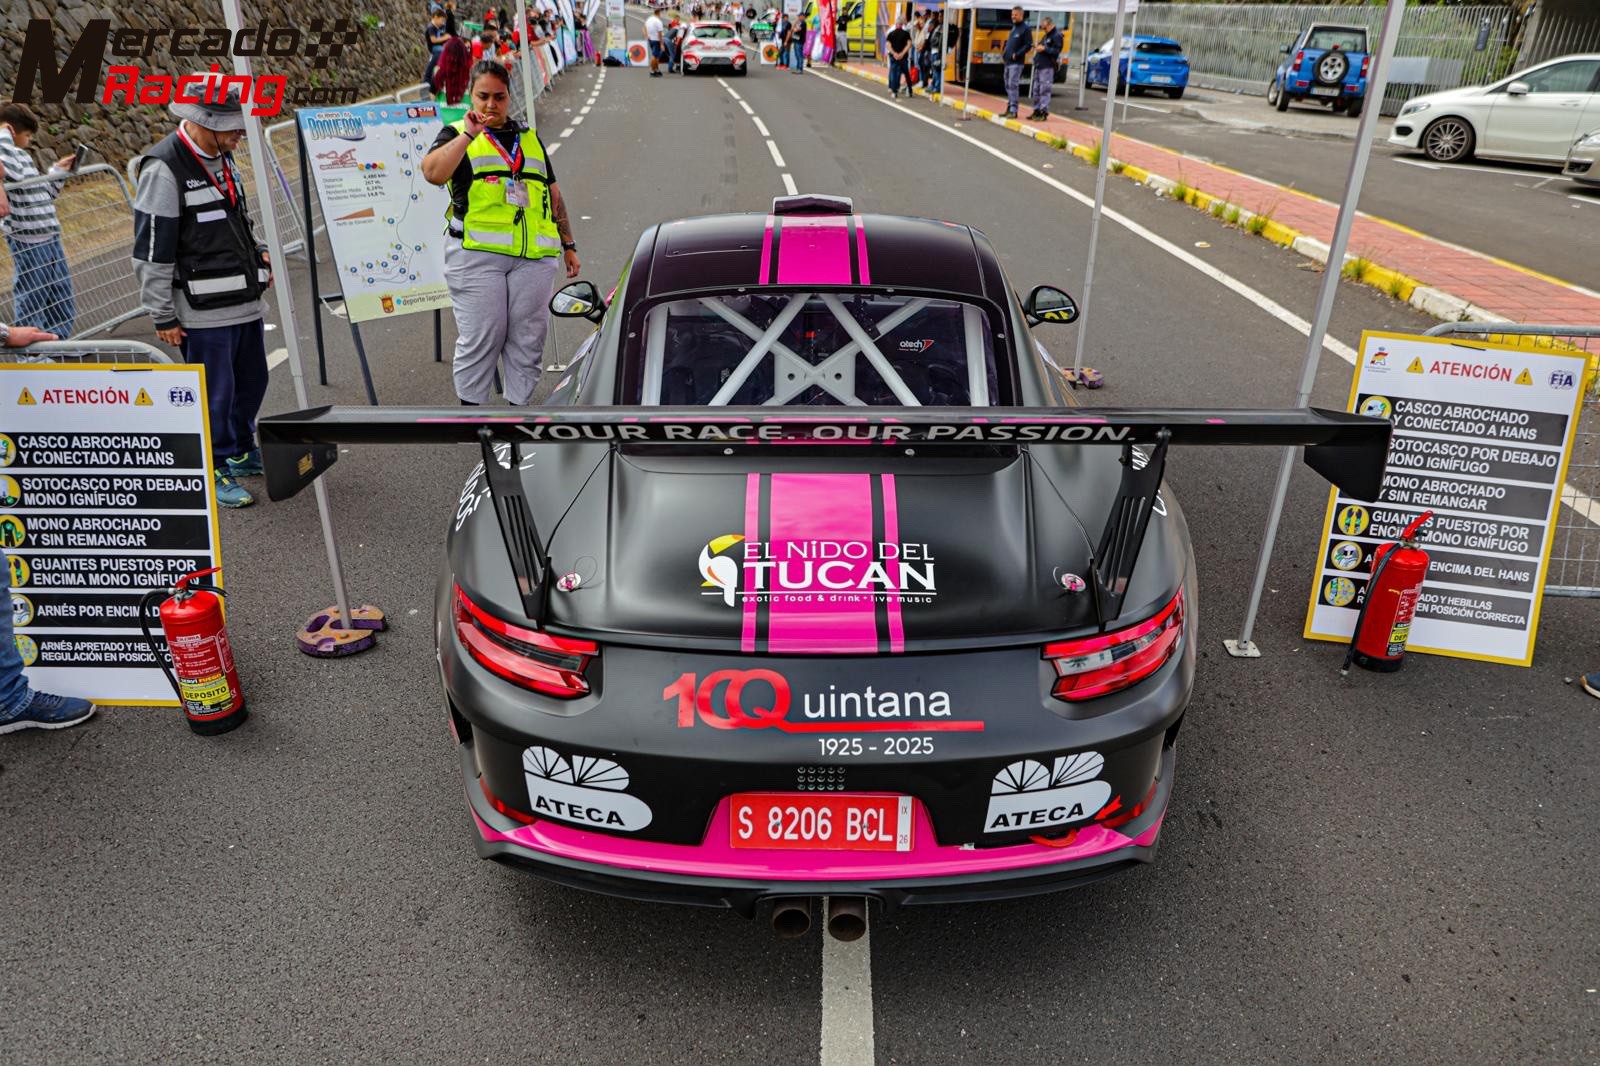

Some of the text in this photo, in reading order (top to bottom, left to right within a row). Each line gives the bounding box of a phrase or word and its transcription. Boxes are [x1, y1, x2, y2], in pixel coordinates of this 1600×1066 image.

[1429, 360, 1512, 382] ATENCIÓN
[42, 386, 130, 404] ATENCIÓN
[1395, 400, 1529, 426] CASCO ABROCHADO
[514, 425, 1136, 440] YOUR RACE. OUR PASSION.
[1392, 414, 1538, 440] Y CONECTADO A HANS
[18, 436, 162, 450] CASCO ABROCHADO
[20, 452, 174, 466] Y CONECTADO A HANS
[1390, 438, 1557, 468] SOTOCASCO POR DEBAJO
[1386, 452, 1490, 474] MONO IGNÍFUGO
[22, 478, 202, 492] SOTOCASCO POR DEBAJO
[1382, 476, 1506, 499] MONO ABROCHADO
[24, 490, 138, 506] MONO IGNÍFUGO
[1388, 490, 1410, 502] SIN
[1412, 492, 1488, 511] REMANGAR
[26, 518, 162, 531] MONO ABROCHADO
[1372, 510, 1530, 540] GUANTS PUESTOS POR
[28, 534, 147, 547] Y SIN REMANGAR
[1421, 530, 1462, 546] MONO
[1464, 534, 1528, 554] IGNÍFUGO
[744, 542, 777, 560] EL
[878, 542, 935, 561] DEL
[32, 558, 196, 572] GUANTES PUESTOS POR
[1430, 562, 1530, 582] ENCIMA DEL HANS
[33, 572, 86, 586] ENCIMA
[88, 573, 130, 586] MONO
[743, 560, 937, 590] TUCAN
[742, 594, 932, 604] exotic food & drink live music
[1440, 596, 1447, 604] Y
[1448, 597, 1492, 610] HEBILLAS
[38, 602, 76, 616] ARNÉS
[80, 606, 103, 616] POR
[1416, 602, 1526, 625] EN POSICIÓN CORRECTA
[40, 640, 72, 650] ARNÉS
[74, 642, 124, 651] APRETADO
[126, 642, 132, 651] Y
[42, 650, 104, 662] REGULACIÓN
[107, 652, 118, 662] EN
[120, 652, 159, 662] POSICIÓ
[184, 686, 227, 699] DEPOSITO
[818, 738, 863, 756] 1925
[884, 737, 934, 756] 2025
[536, 795, 626, 826] ATECA
[990, 802, 1084, 829] ATECA
[738, 806, 893, 842] S 8206 BCL
[898, 834, 909, 845] 26
